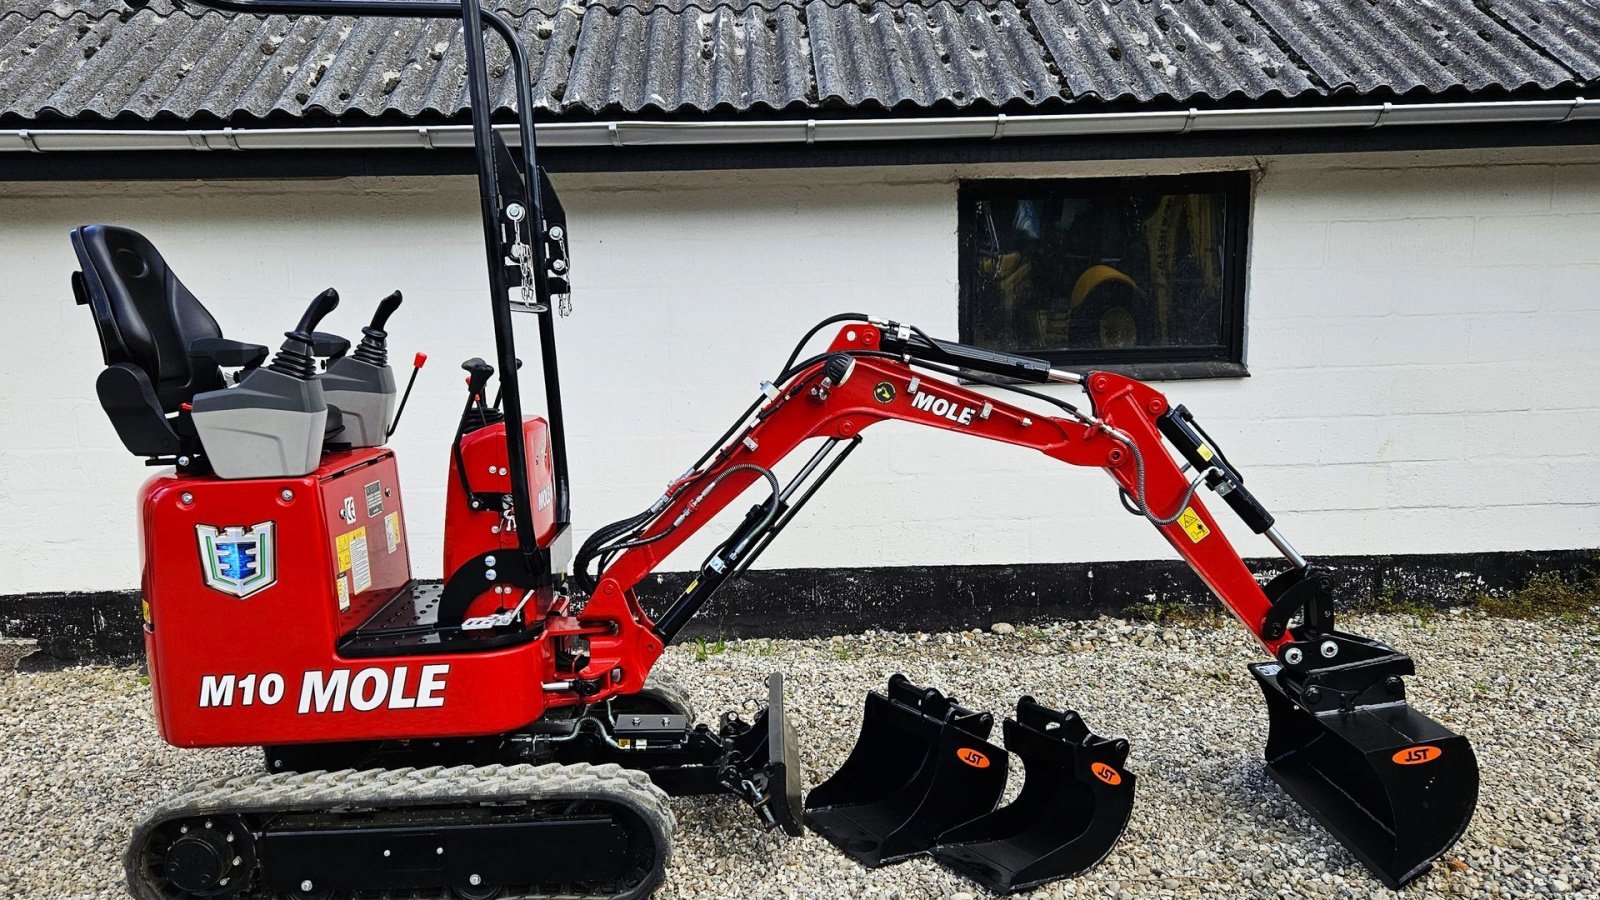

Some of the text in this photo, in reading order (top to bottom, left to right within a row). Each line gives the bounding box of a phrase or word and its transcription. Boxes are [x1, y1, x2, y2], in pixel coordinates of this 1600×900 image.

[911, 391, 976, 425] MOLE
[199, 664, 450, 714] M10 MOLE
[965, 752, 984, 764] JST
[1404, 749, 1429, 762] JST
[1098, 767, 1115, 781] JST
